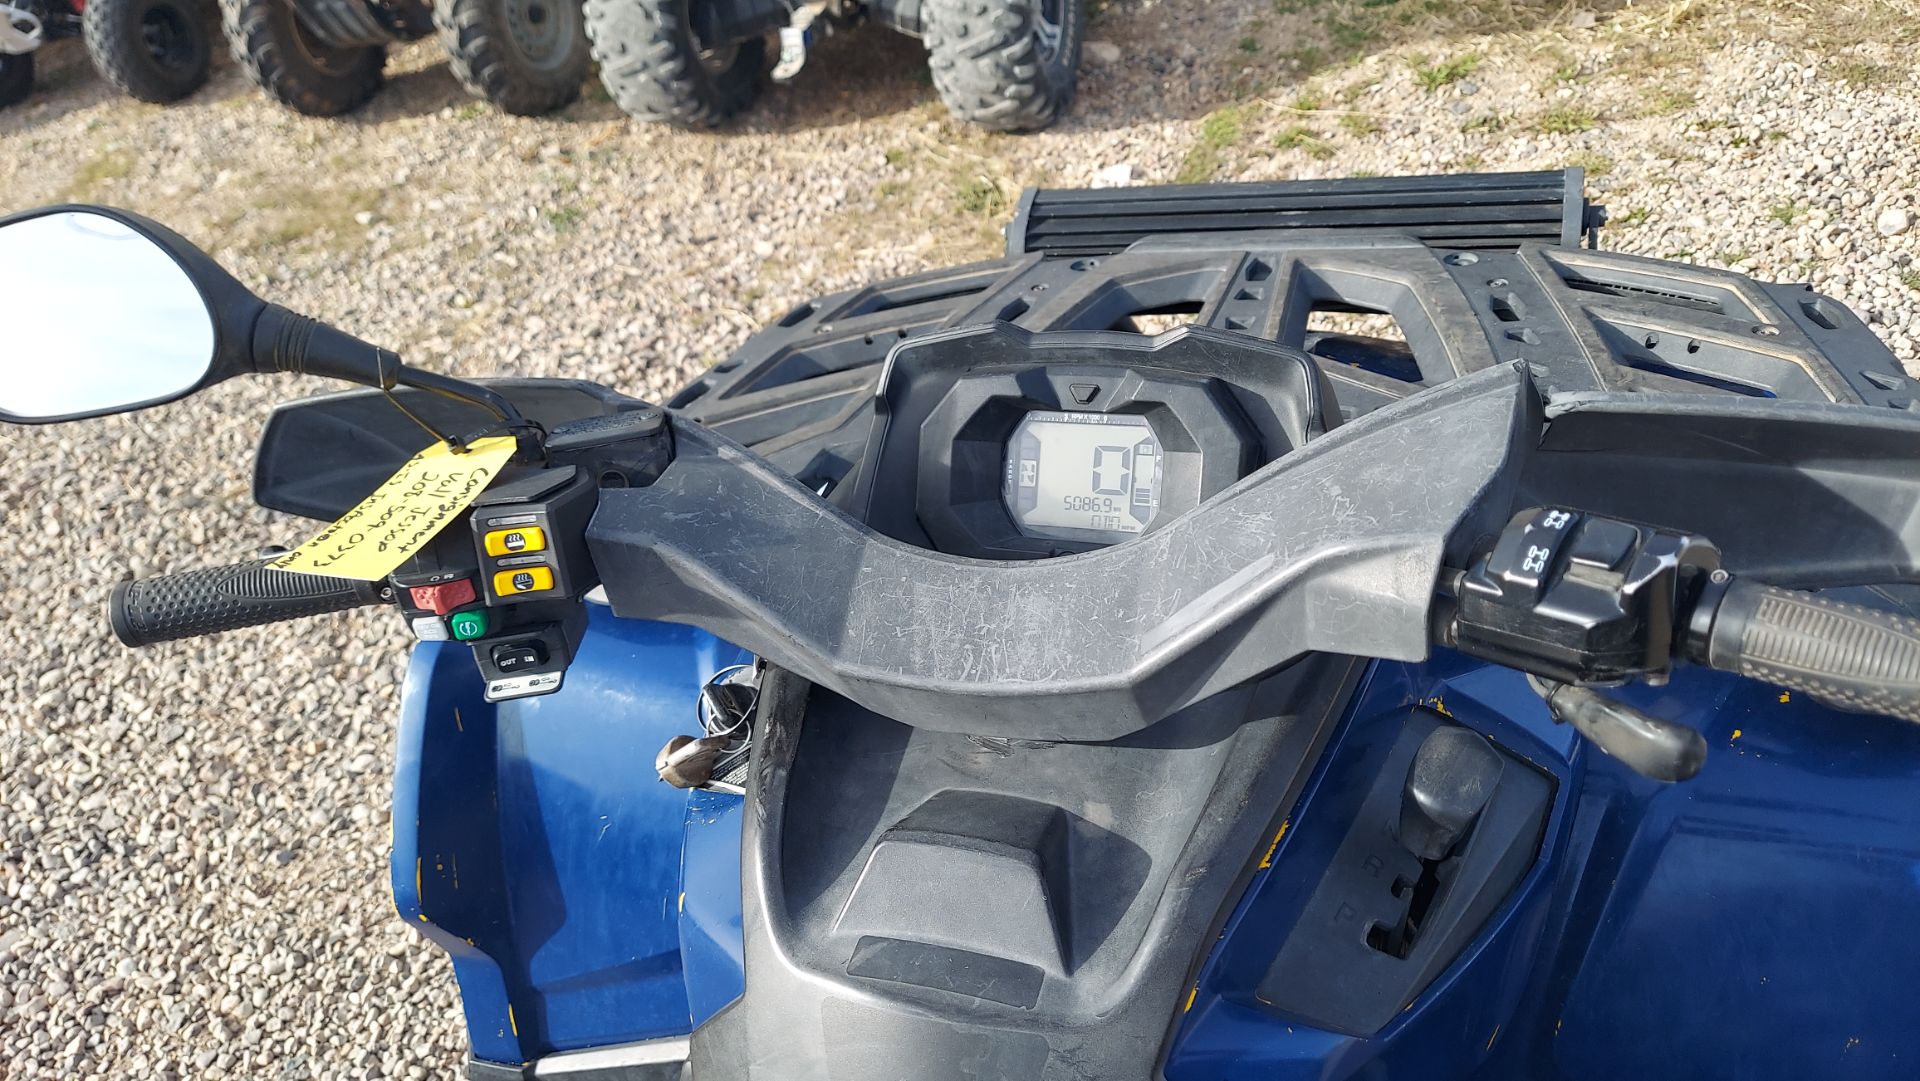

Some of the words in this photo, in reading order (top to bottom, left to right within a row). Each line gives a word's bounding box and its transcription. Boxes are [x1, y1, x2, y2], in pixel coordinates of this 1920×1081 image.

[1092, 445, 1131, 496] 0
[398, 467, 489, 554] Consignment
[1063, 495, 1113, 513] 5086.9
[500, 657, 517, 667] OUT
